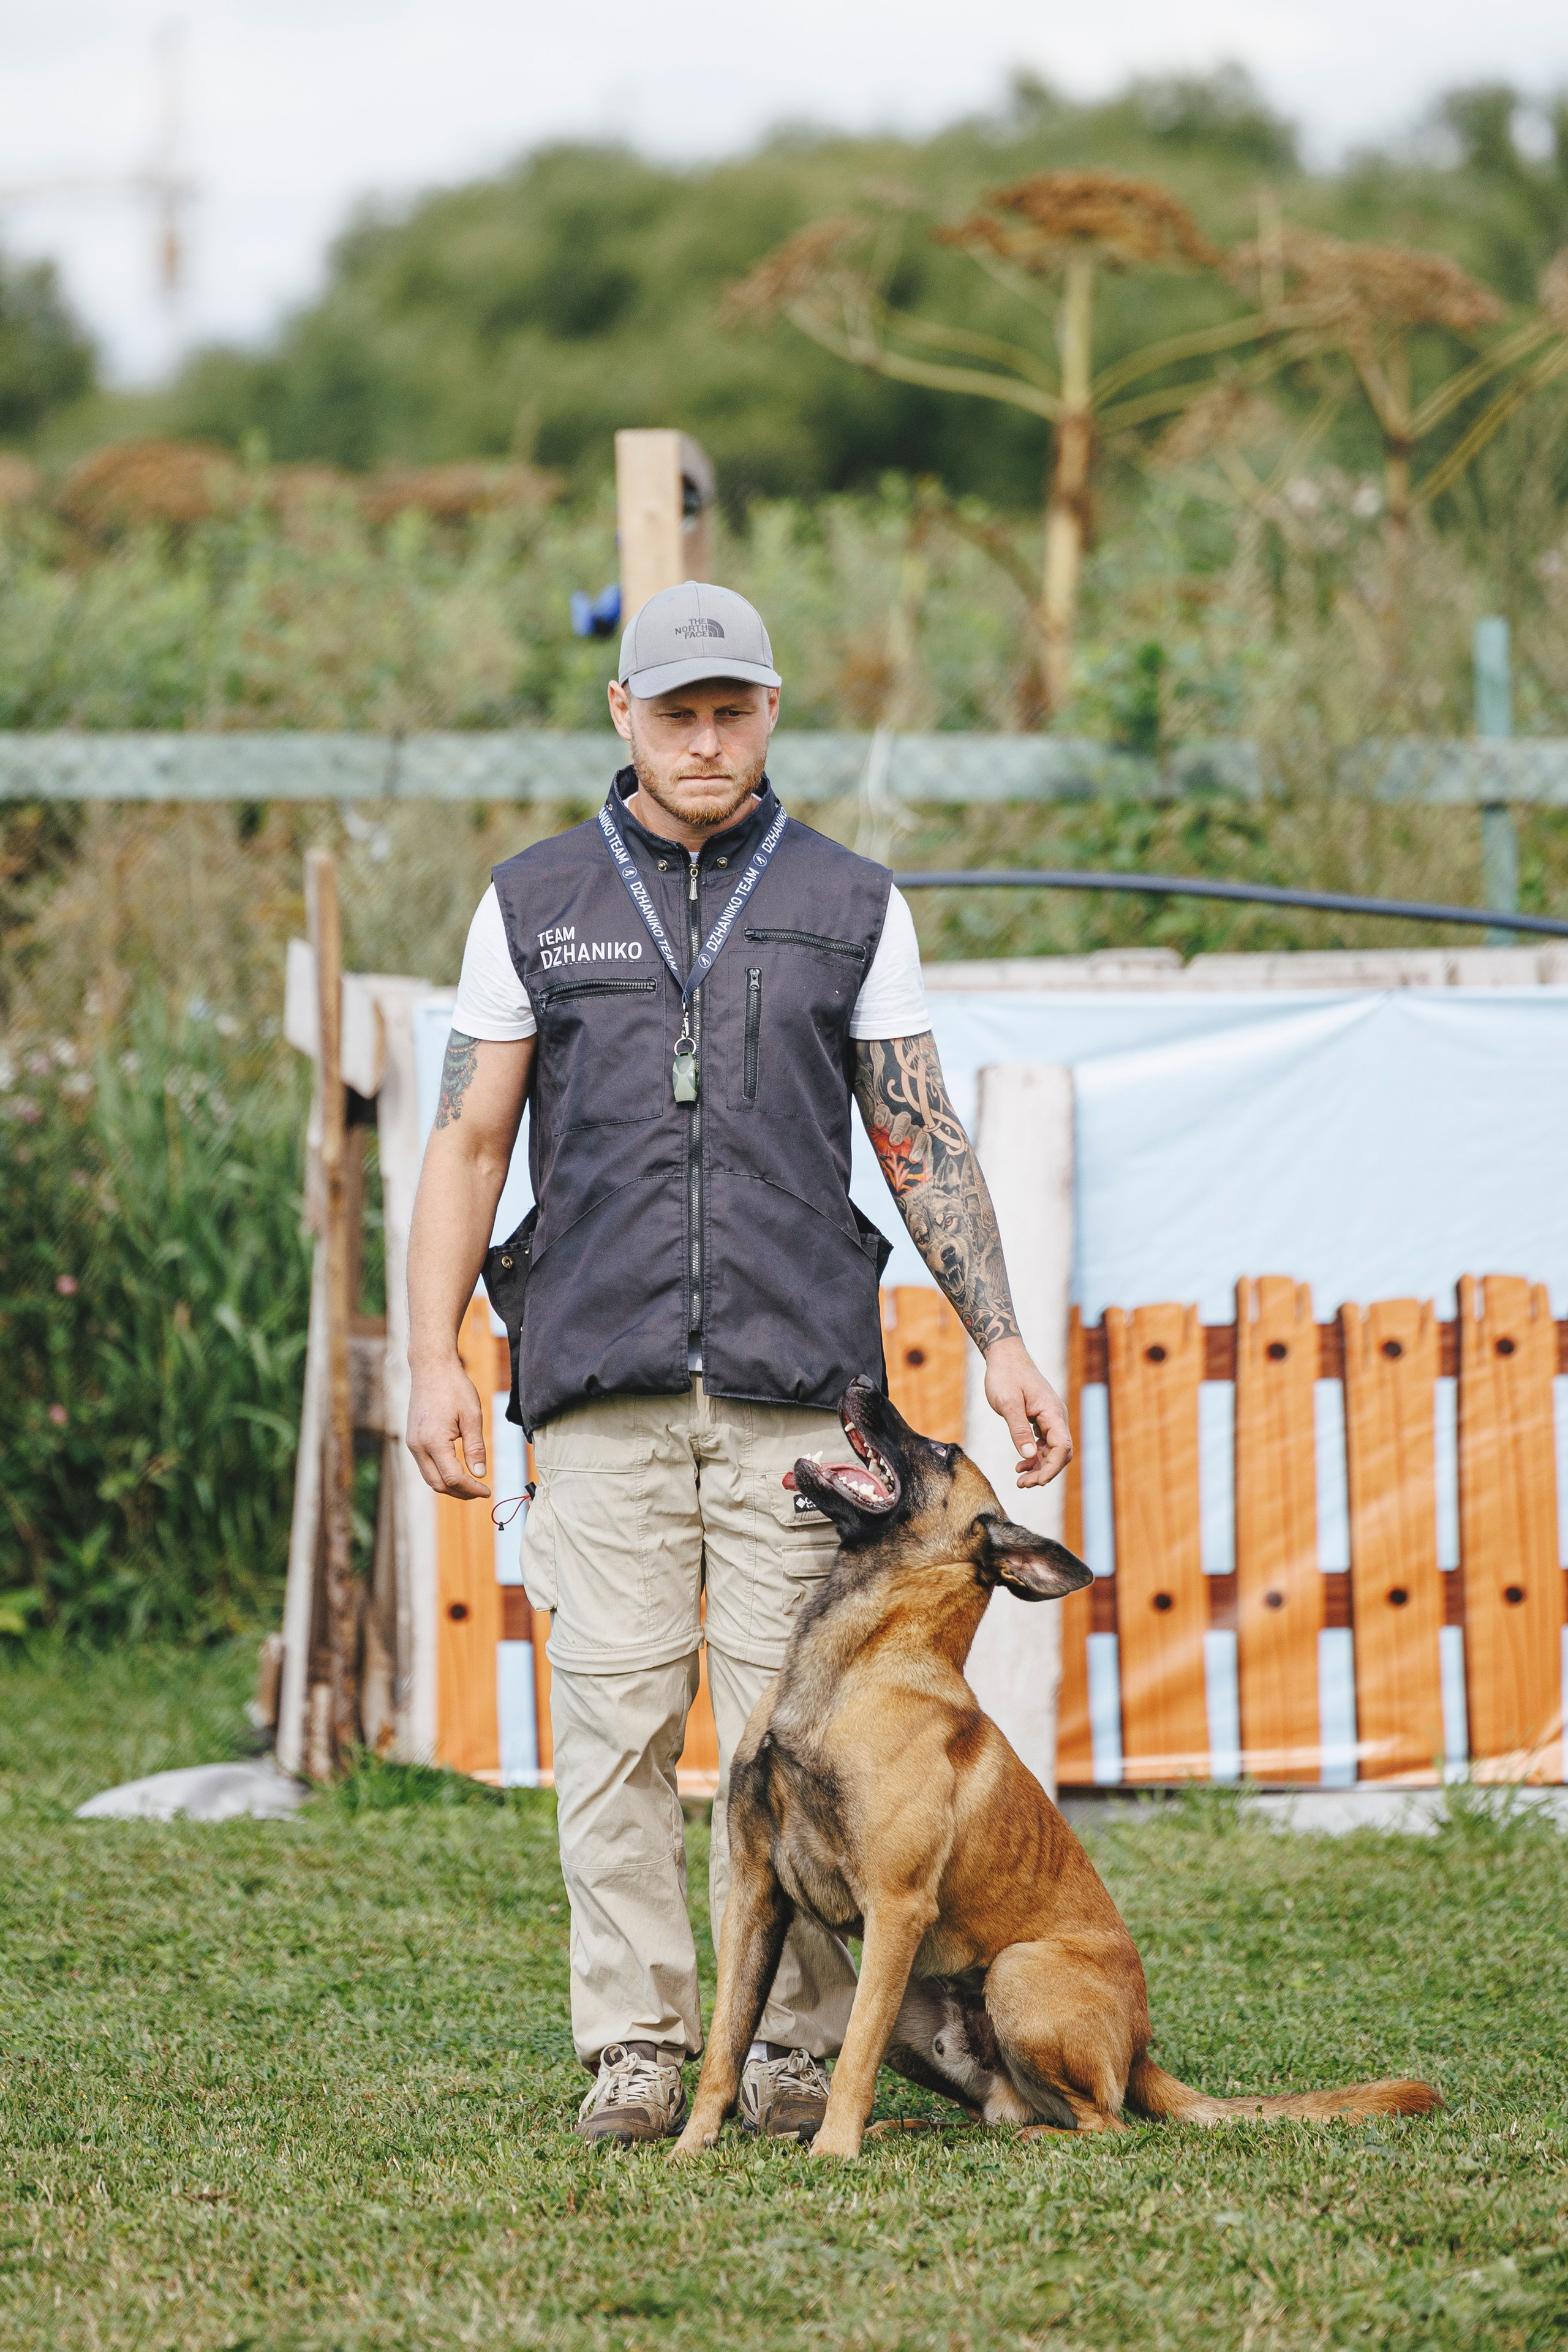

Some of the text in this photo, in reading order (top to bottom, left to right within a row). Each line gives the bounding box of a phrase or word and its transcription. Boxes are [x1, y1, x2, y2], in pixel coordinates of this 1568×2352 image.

[675, 625, 707, 635] NORTH
[761, 806, 787, 854] DZHANIKO
[608, 834, 630, 864] TEAM
[706, 867, 760, 952] DZHANIKO TEAM
[537, 926, 575, 947] TEAM
[630, 881, 678, 971] DZHANIKO TEAM
[540, 941, 643, 970] DZHANIKO
